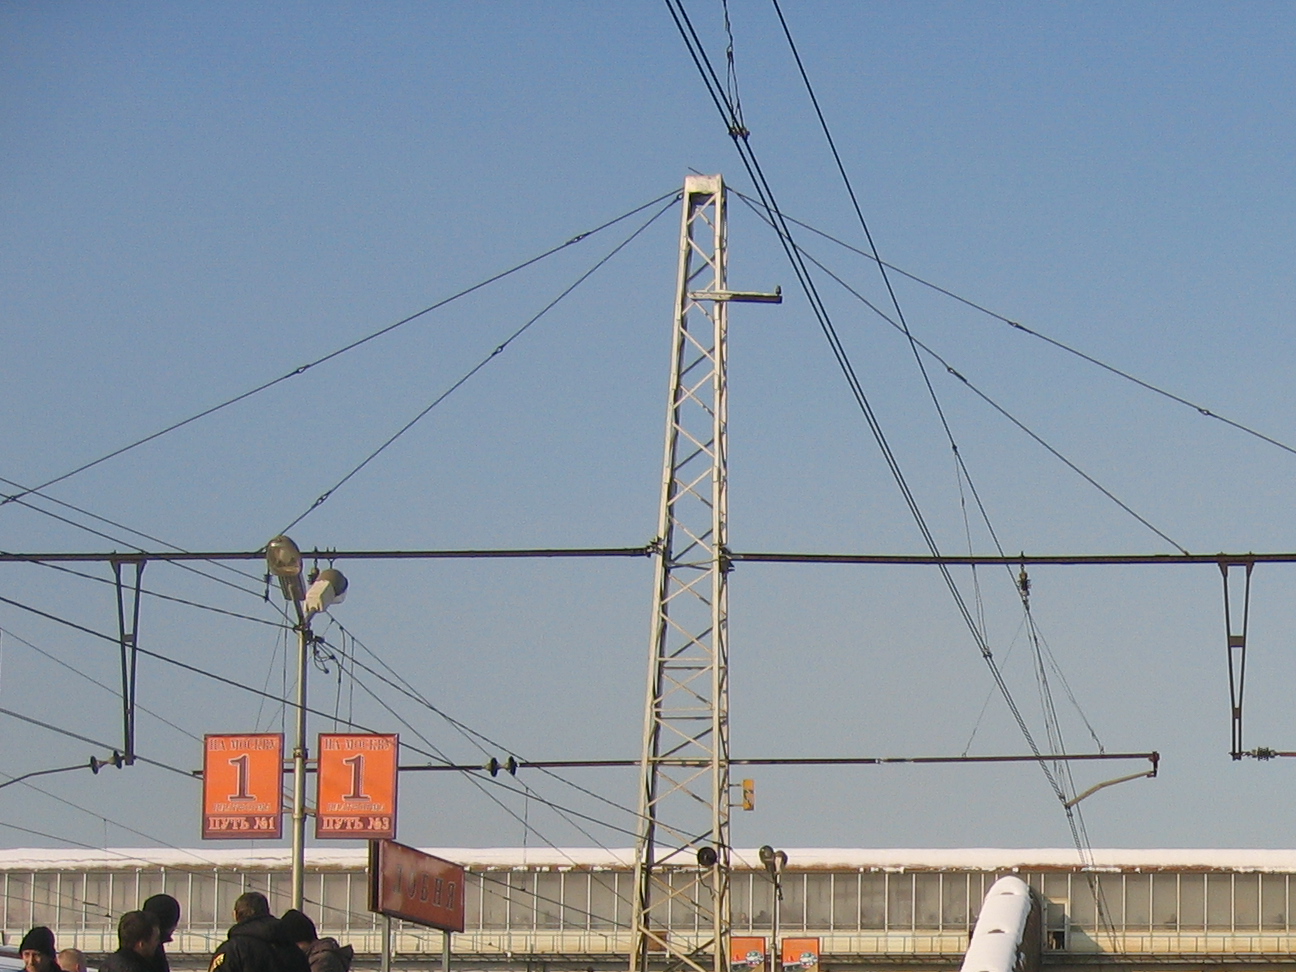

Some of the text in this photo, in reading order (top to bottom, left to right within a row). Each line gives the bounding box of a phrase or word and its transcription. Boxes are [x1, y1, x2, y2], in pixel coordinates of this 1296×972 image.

[208, 737, 226, 751] НА
[323, 737, 341, 751] НА
[228, 752, 258, 802] 1
[342, 753, 372, 802] 1
[208, 816, 250, 830] ПУТЬ
[322, 816, 390, 830] ПУТЬ №3
